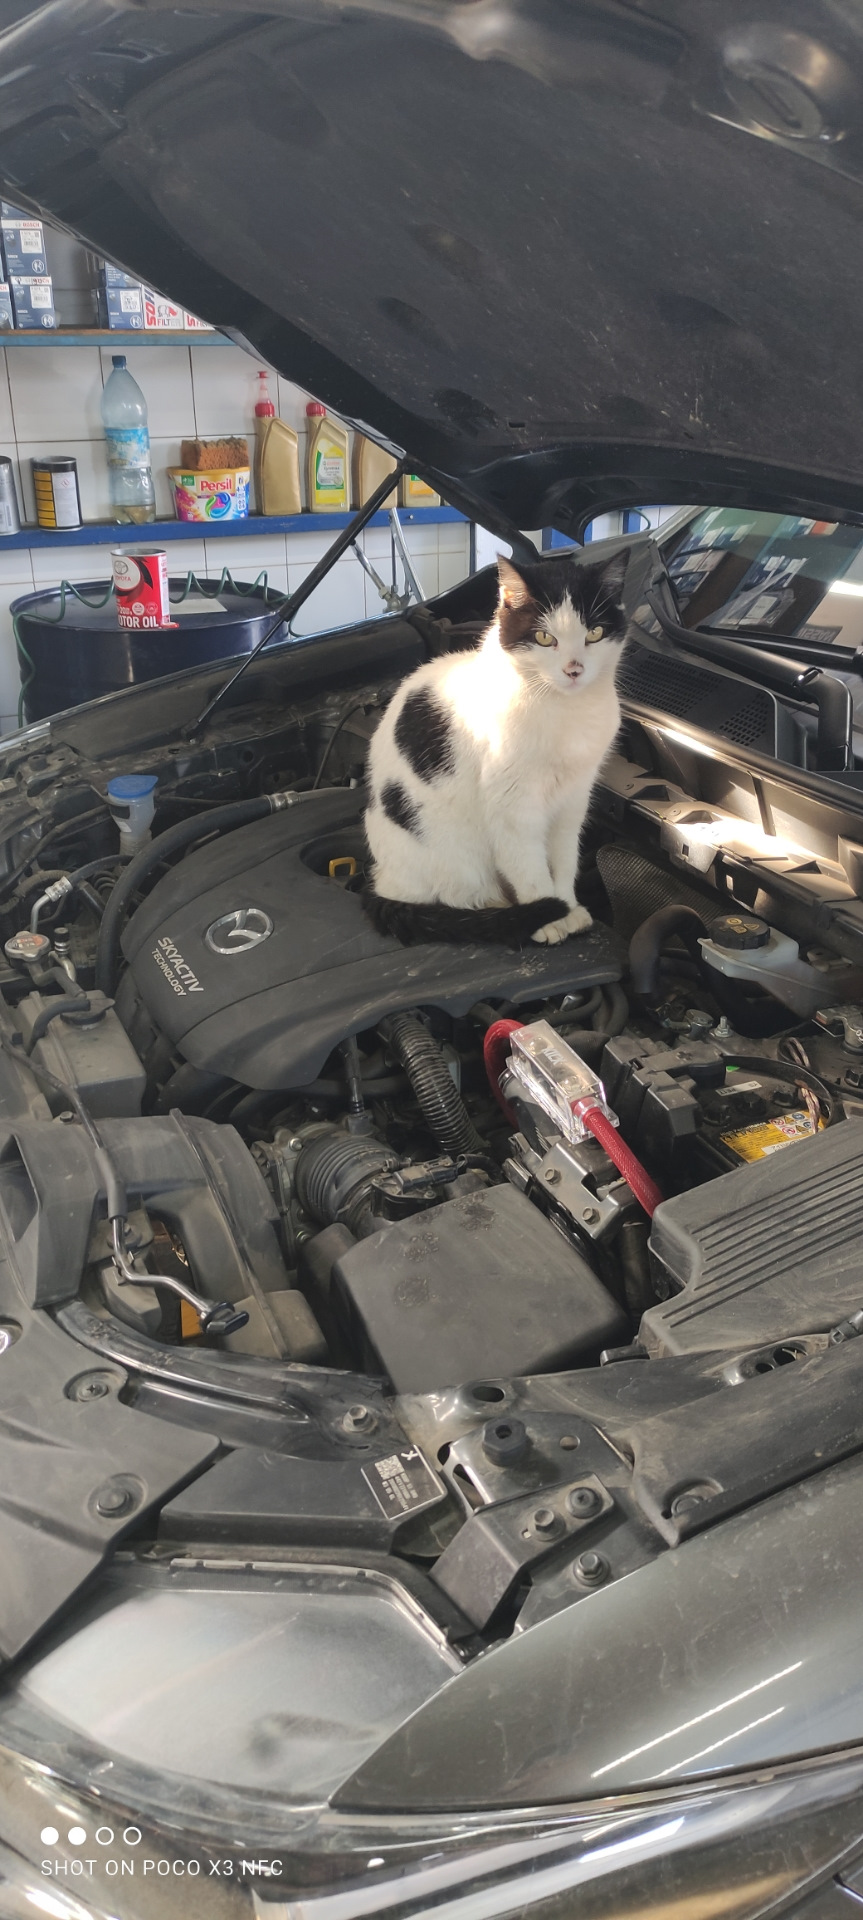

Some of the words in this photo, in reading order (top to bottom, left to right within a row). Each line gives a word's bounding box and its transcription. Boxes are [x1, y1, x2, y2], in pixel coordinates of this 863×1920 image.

[200, 478, 232, 492] Persil
[118, 613, 140, 629] OTOR
[142, 615, 159, 628] OIL
[151, 948, 187, 996] TECHNOLOGY
[157, 937, 204, 991] SKYACTIV
